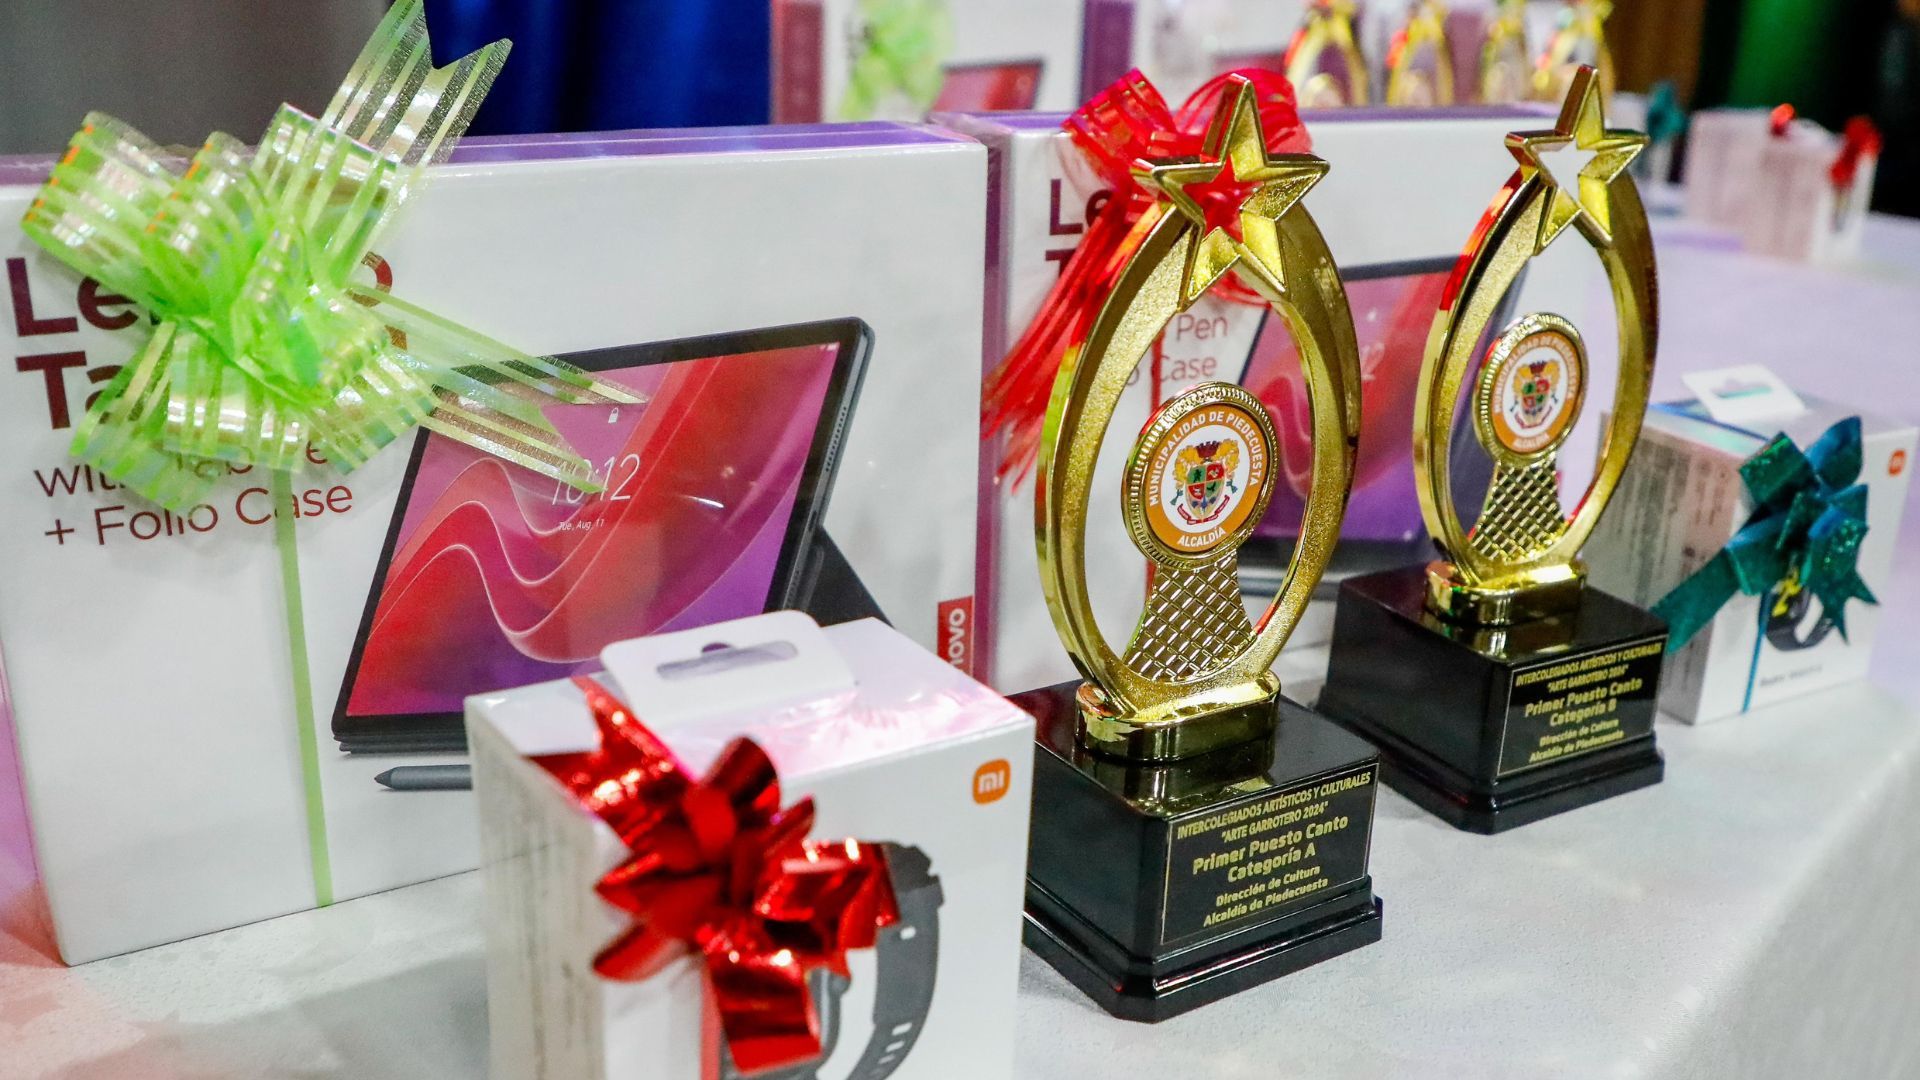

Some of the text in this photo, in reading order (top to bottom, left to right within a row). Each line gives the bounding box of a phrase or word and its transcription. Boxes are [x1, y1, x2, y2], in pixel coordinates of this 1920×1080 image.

[1177, 313, 1228, 341] Pen
[1150, 411, 1262, 506] MUNICIPALIDAD DE PIEDECUESTA
[94, 503, 218, 546] Folio
[1177, 526, 1226, 548] ALCALDÍA
[1525, 697, 1565, 718] Primer
[1567, 686, 1607, 707] Puesto
[1177, 771, 1371, 840] INTERCOLEGIADOS ARTÍSTICOS Y CULTURALES
[1221, 825, 1248, 843] "ARTE
[1249, 808, 1302, 835] GARROTERO
[1192, 815, 1349, 875] Primer Puesto Canto
[1227, 842, 1316, 883] Categoría A
[1203, 877, 1329, 928] Alcaldía de Piedecuesta
[1215, 865, 1321, 907] Dirección de Cultura
